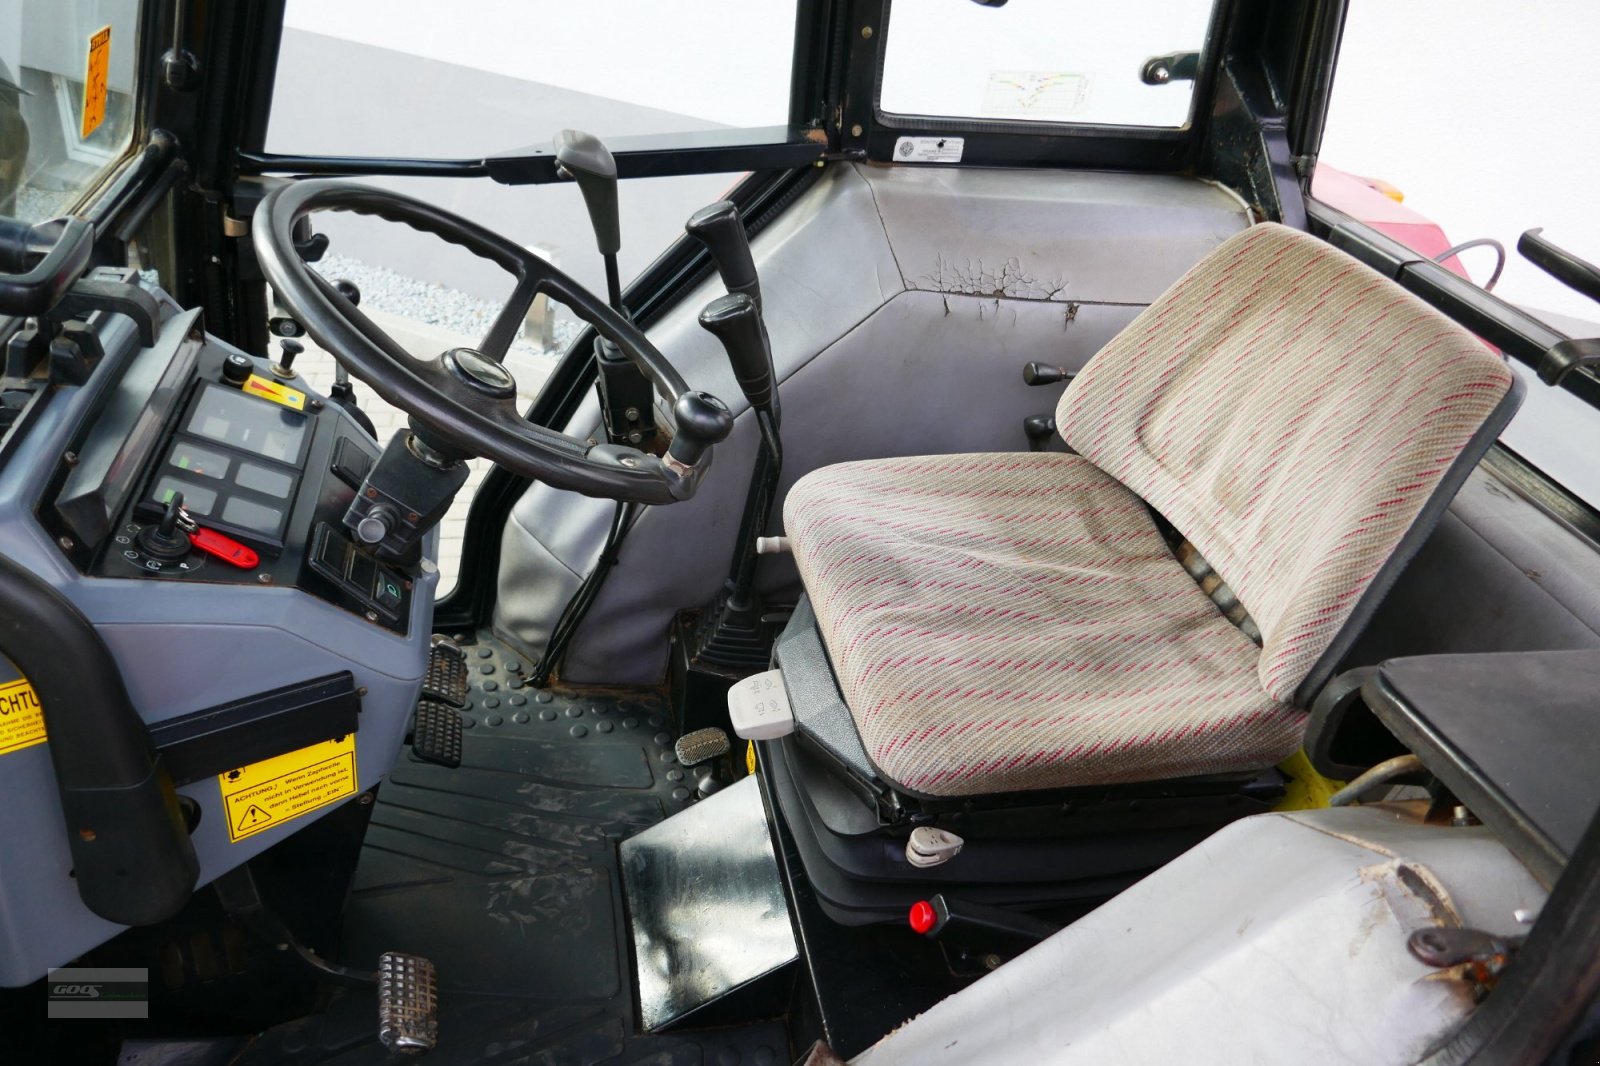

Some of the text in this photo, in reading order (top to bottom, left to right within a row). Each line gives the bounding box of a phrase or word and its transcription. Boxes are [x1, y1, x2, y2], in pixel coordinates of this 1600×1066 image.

[0, 690, 39, 715] CHTU
[264, 791, 283, 802] nicht
[293, 772, 337, 791] Verwendung
[269, 775, 349, 809] dann Hebel nach vorne
[291, 795, 322, 810] Stellung
